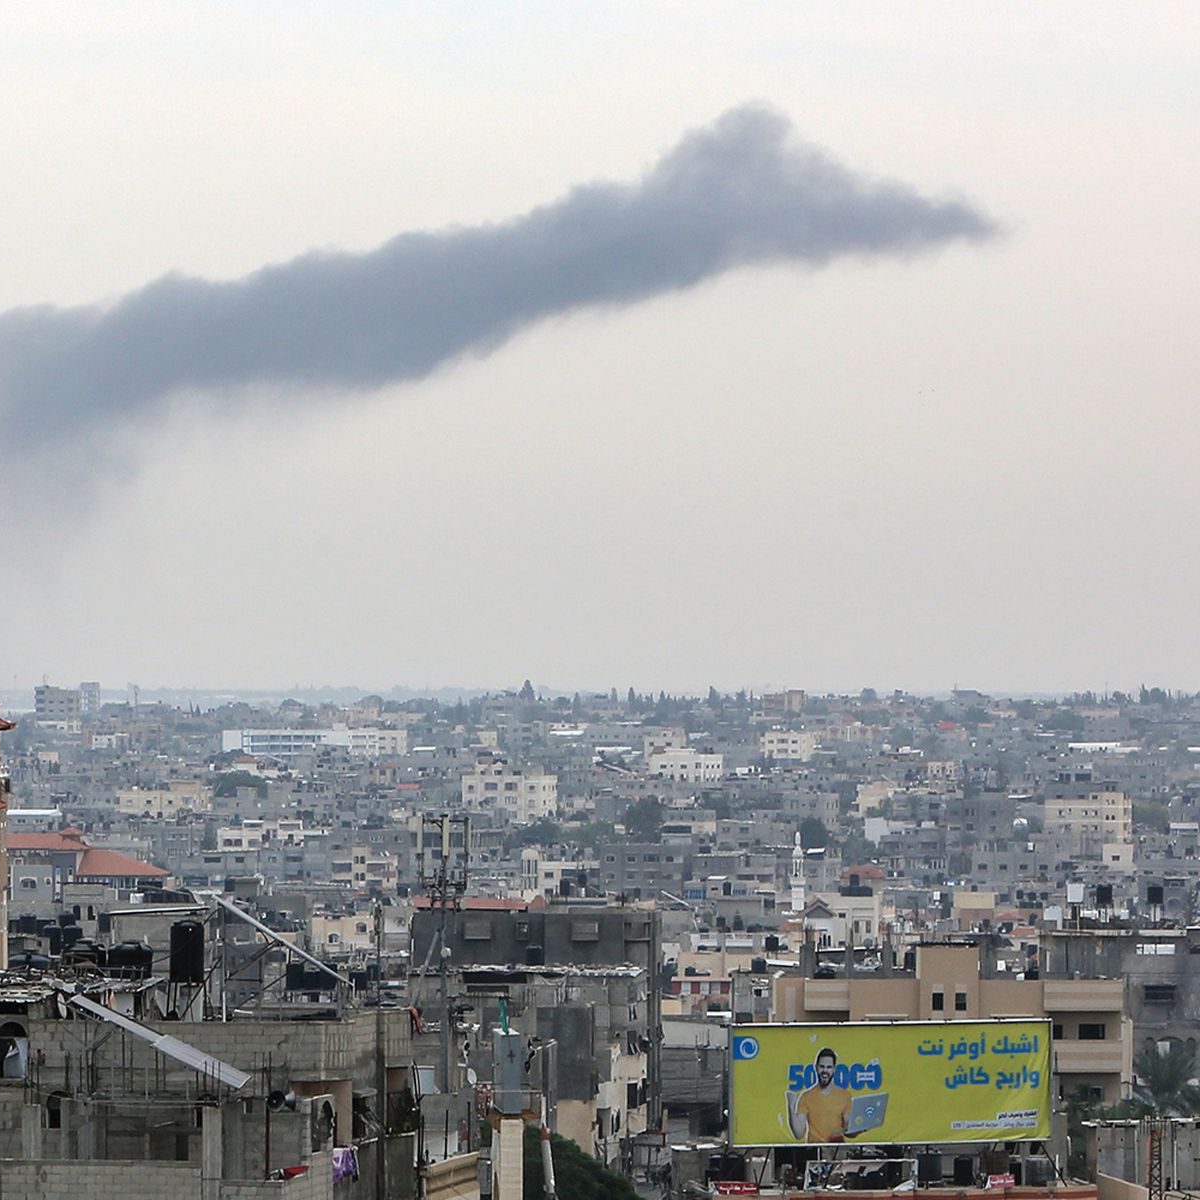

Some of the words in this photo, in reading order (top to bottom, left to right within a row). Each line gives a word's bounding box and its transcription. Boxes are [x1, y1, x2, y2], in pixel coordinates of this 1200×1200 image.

[918, 1038, 944, 1056] نت
[948, 1031, 986, 1061] أوفر
[992, 1033, 1039, 1060] اشبك
[945, 1064, 990, 1090] كاش
[996, 1065, 1039, 1090] واربح
